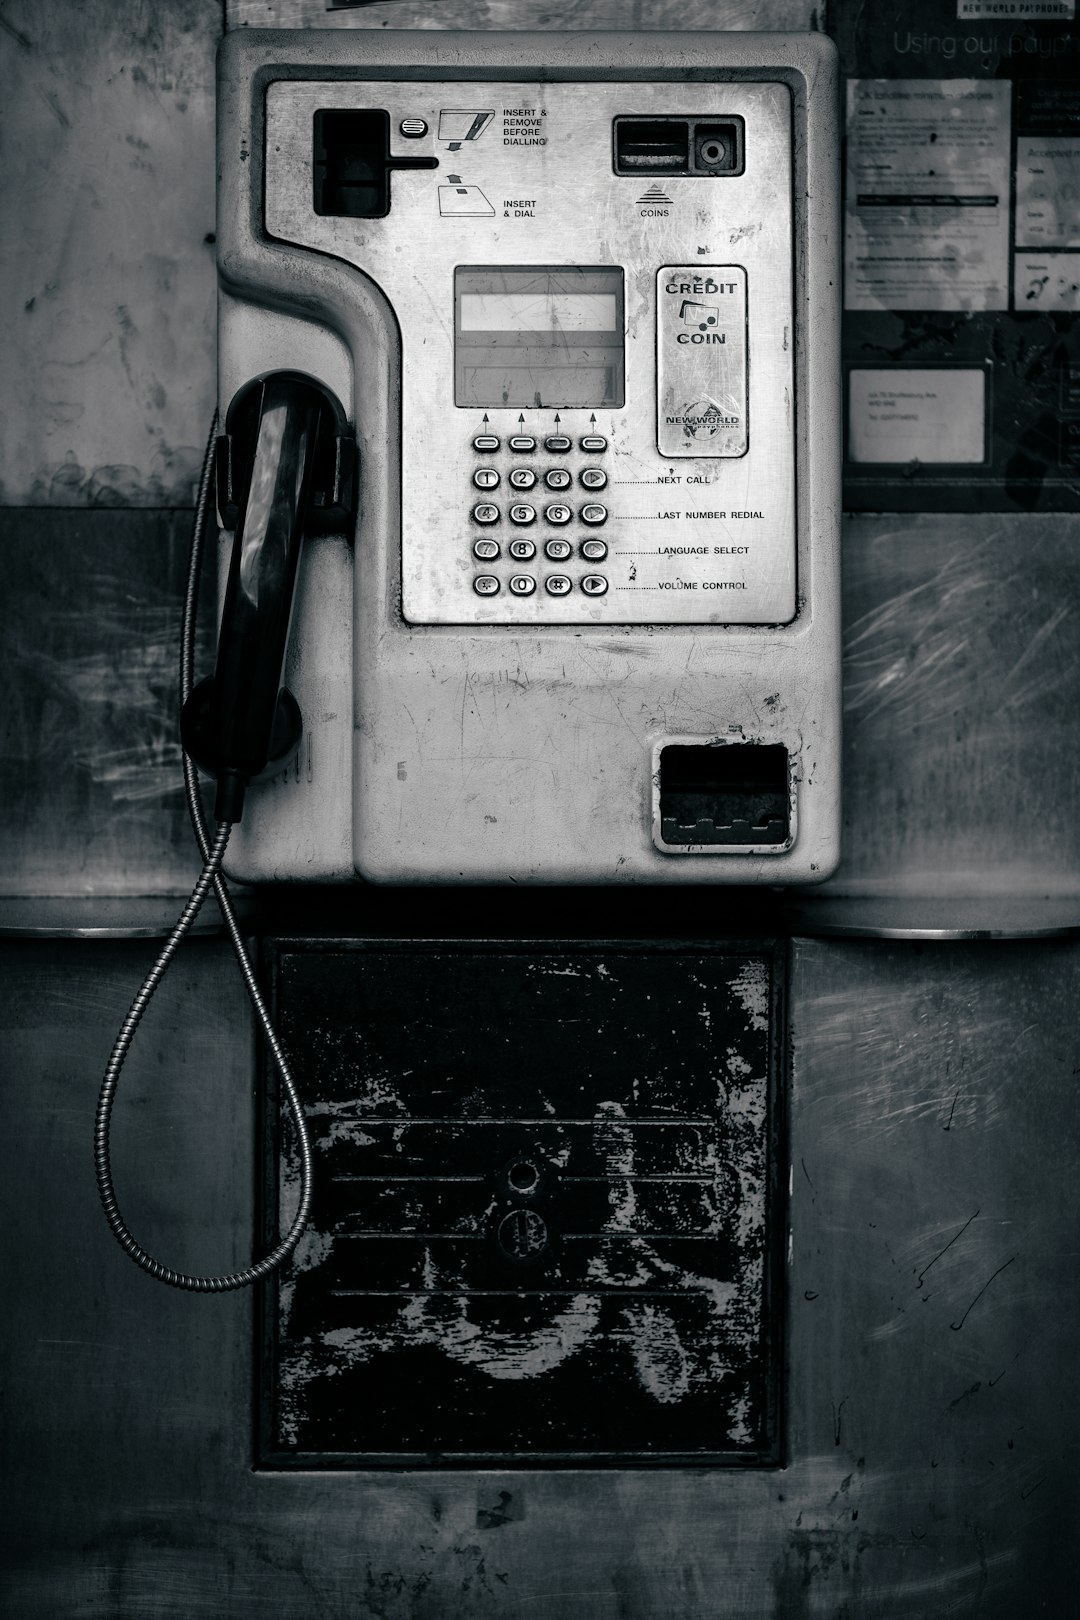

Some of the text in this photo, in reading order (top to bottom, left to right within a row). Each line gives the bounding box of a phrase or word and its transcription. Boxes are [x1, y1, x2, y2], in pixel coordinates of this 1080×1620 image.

[985, 4, 1016, 13] WORLD
[893, 31, 956, 59] Using
[964, 36, 999, 54] our
[503, 109, 548, 117] INSERT &
[503, 118, 543, 126] REMOVE
[503, 128, 541, 136] BEFORE
[503, 138, 547, 146] DIALLING
[503, 210, 536, 218] & DIAL
[640, 209, 670, 217] COINS
[665, 283, 738, 294] CREDIT
[676, 333, 726, 345] COIN
[483, 473, 562, 485] 1 2 3
[657, 476, 711, 484] NEXT CALL
[518, 508, 527, 519] 5
[554, 508, 563, 519] 6
[658, 511, 765, 519] LAST NUMBER REDIAL
[482, 543, 562, 555] 7 8 9
[658, 547, 710, 555] LANGUAGE
[518, 579, 527, 591] 0
[658, 582, 748, 590] VOLUME CONTROL
